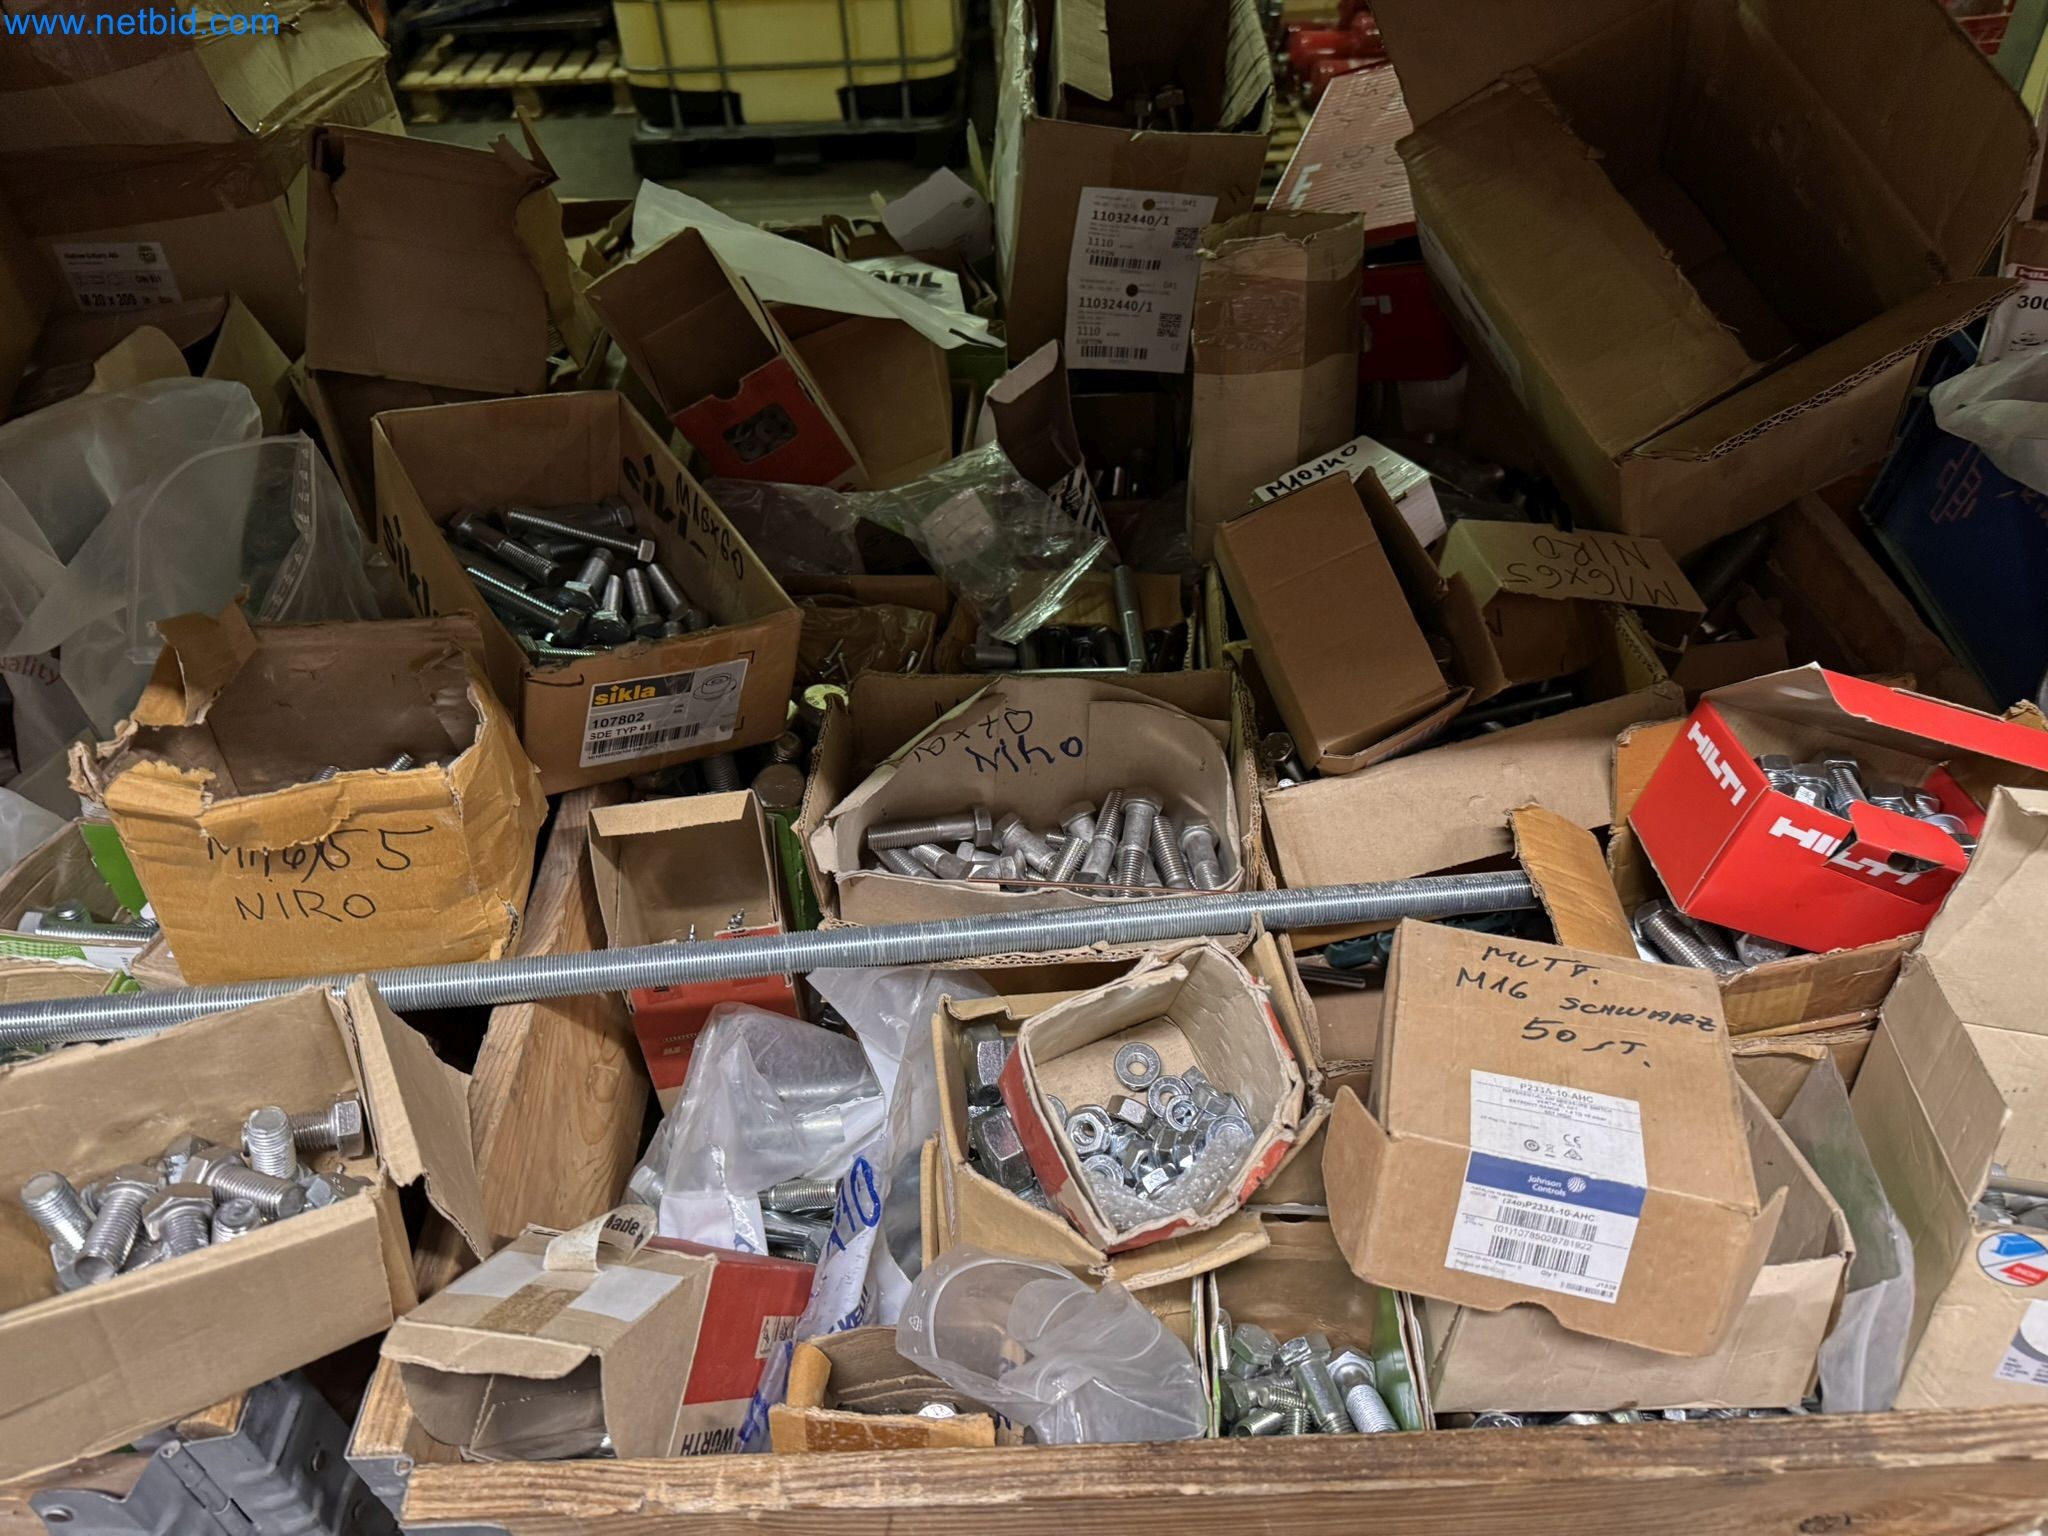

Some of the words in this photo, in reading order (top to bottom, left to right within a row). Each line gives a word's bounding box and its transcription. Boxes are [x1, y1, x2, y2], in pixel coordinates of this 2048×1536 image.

[1091, 210, 1170, 226] 11032440/1
[1088, 236, 1114, 248] 1110
[1078, 297, 1153, 313] 11032440/1
[593, 684, 657, 706] sikla
[592, 711, 645, 730] 107802
[590, 730, 613, 741] SDE
[616, 726, 638, 737] TYP
[1686, 720, 1748, 807] HILTI
[1767, 815, 1922, 886] HILTI
[234, 888, 377, 923] NIRO
[1455, 967, 1529, 1000] M16
[1559, 996, 1718, 1033] SCHWARZ
[1520, 1016, 1577, 1043] 50
[1528, 1174, 1562, 1188] Johnson
[1531, 1183, 1567, 1198] Controls
